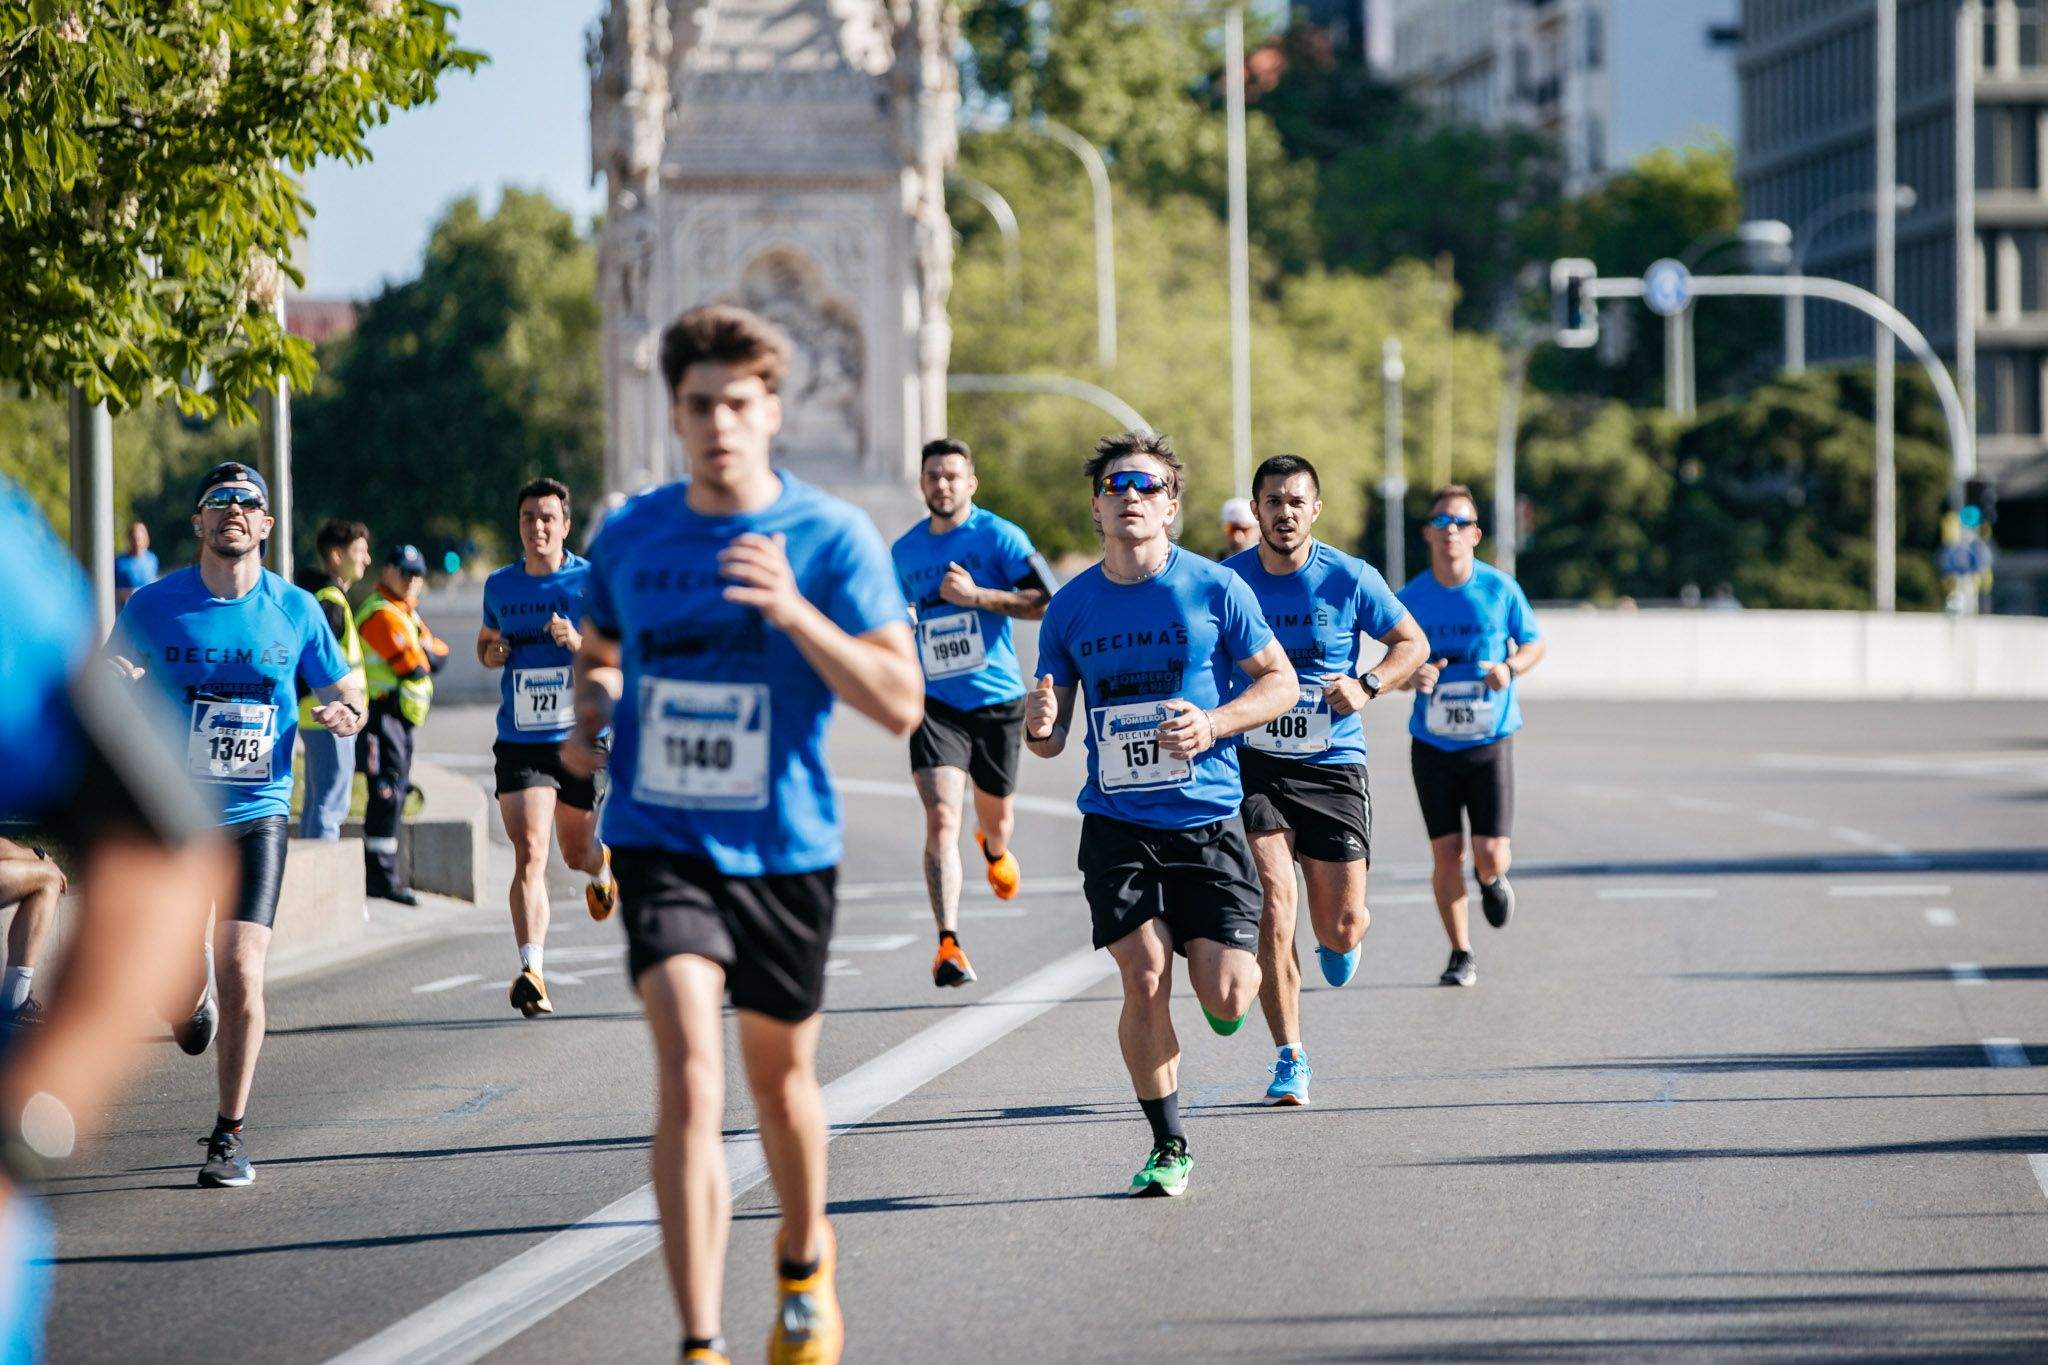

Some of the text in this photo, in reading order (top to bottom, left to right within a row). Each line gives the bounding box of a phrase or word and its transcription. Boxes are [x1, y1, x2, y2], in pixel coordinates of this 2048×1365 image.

[1266, 613, 1328, 629] IMAS
[932, 637, 971, 661] 1990
[1081, 629, 1188, 657] DECIMAS
[167, 646, 289, 665] DECIMAS
[530, 692, 558, 712] 727
[1121, 714, 1165, 726] BOMBEROS
[1266, 715, 1308, 739] 408
[1445, 707, 1475, 724] 763
[208, 736, 259, 762] 1343
[664, 736, 733, 770] 1140
[1122, 740, 1160, 767] 157
